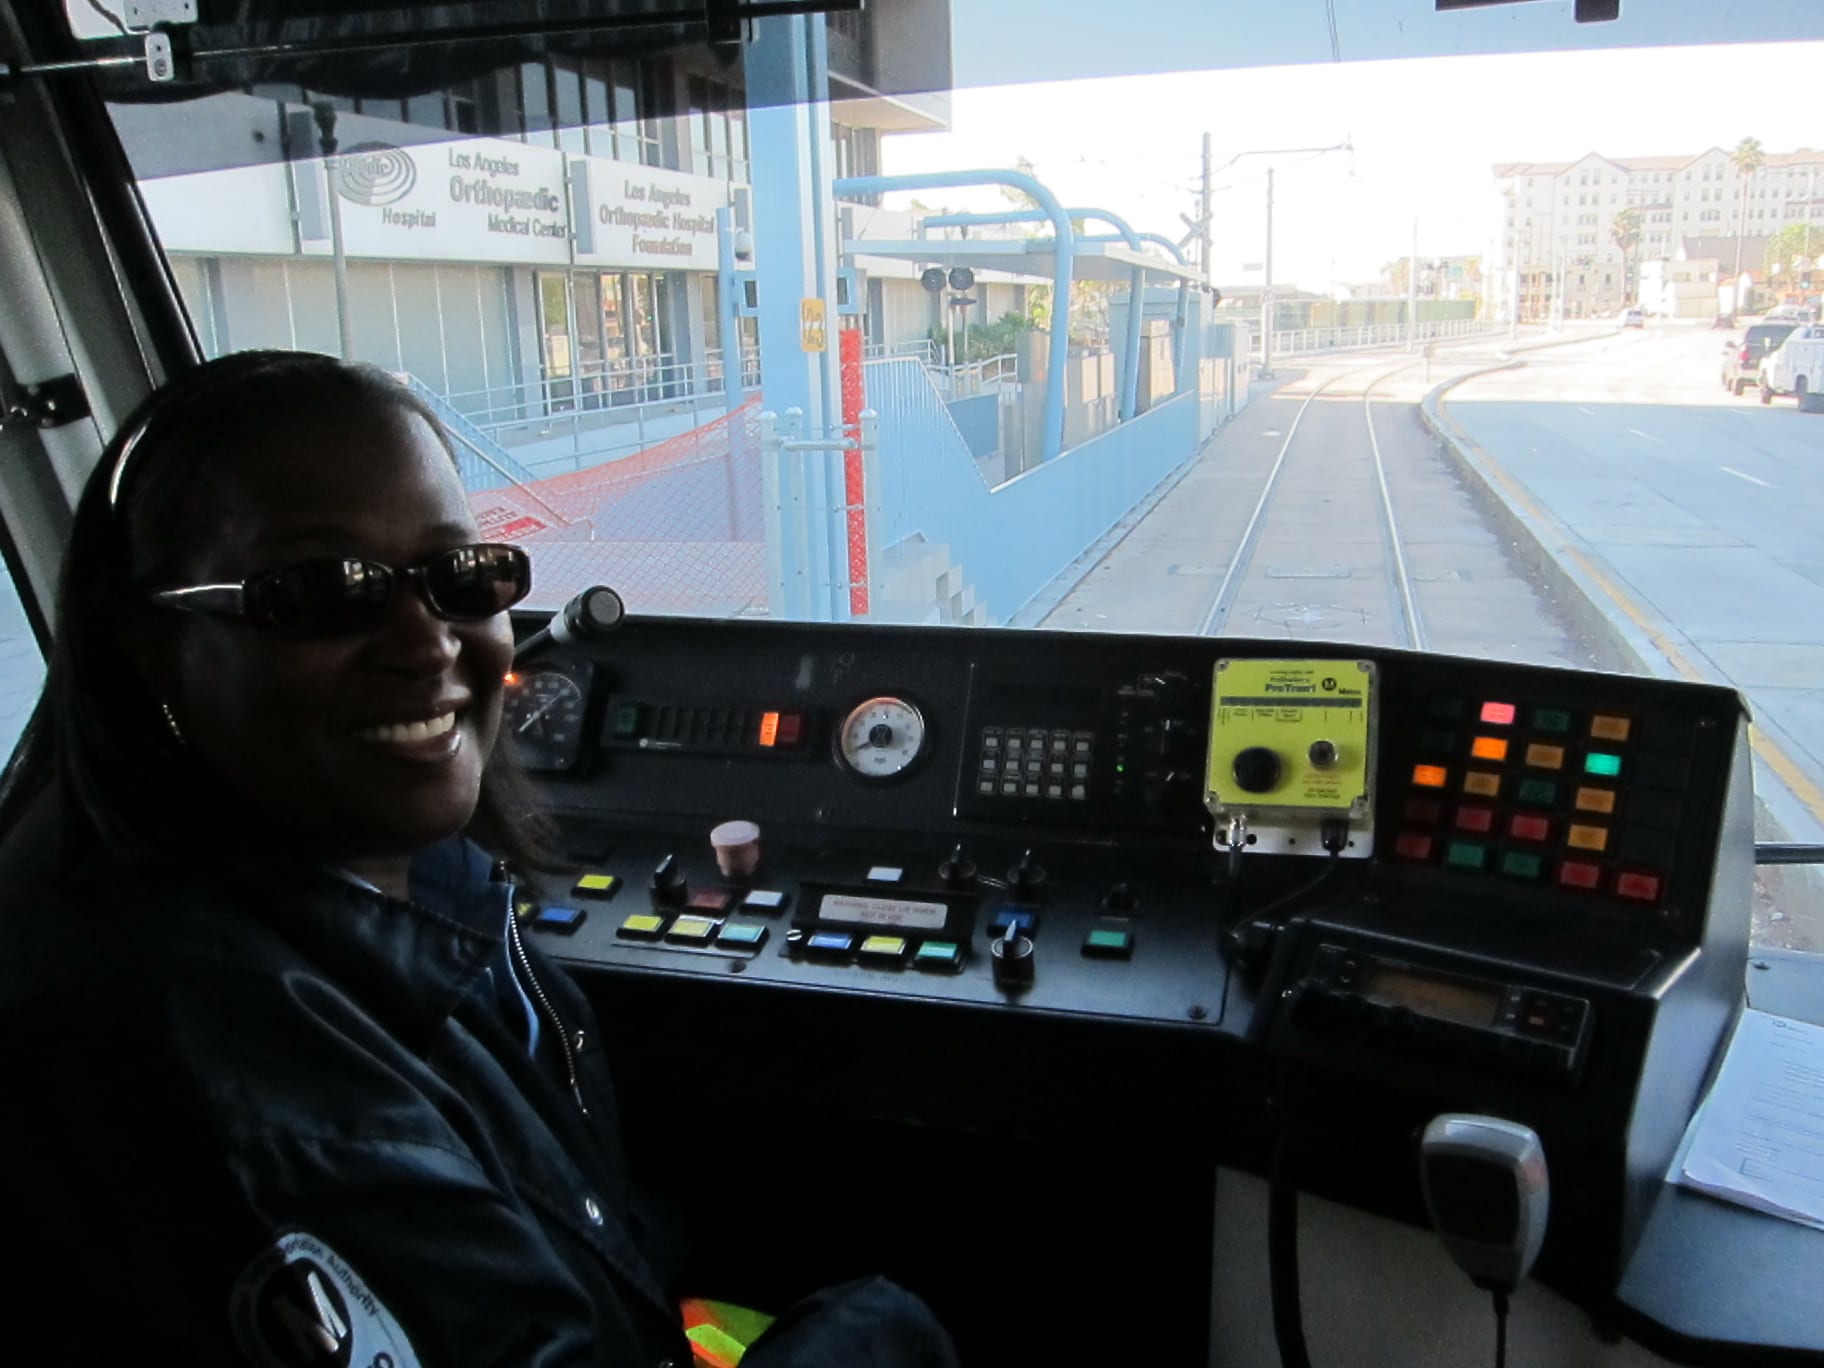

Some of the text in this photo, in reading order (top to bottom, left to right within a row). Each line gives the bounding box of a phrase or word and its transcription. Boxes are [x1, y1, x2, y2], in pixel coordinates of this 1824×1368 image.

[448, 147, 519, 177] Los Angeles
[449, 175, 559, 213] Orthopaedic
[624, 179, 691, 210] Los Angeles
[382, 207, 436, 230] Hospital
[488, 212, 567, 239] Medical Center
[599, 203, 714, 237] Orthopaedic Hospital
[632, 233, 693, 256] Foundation
[327, 1253, 379, 1317] Authority
